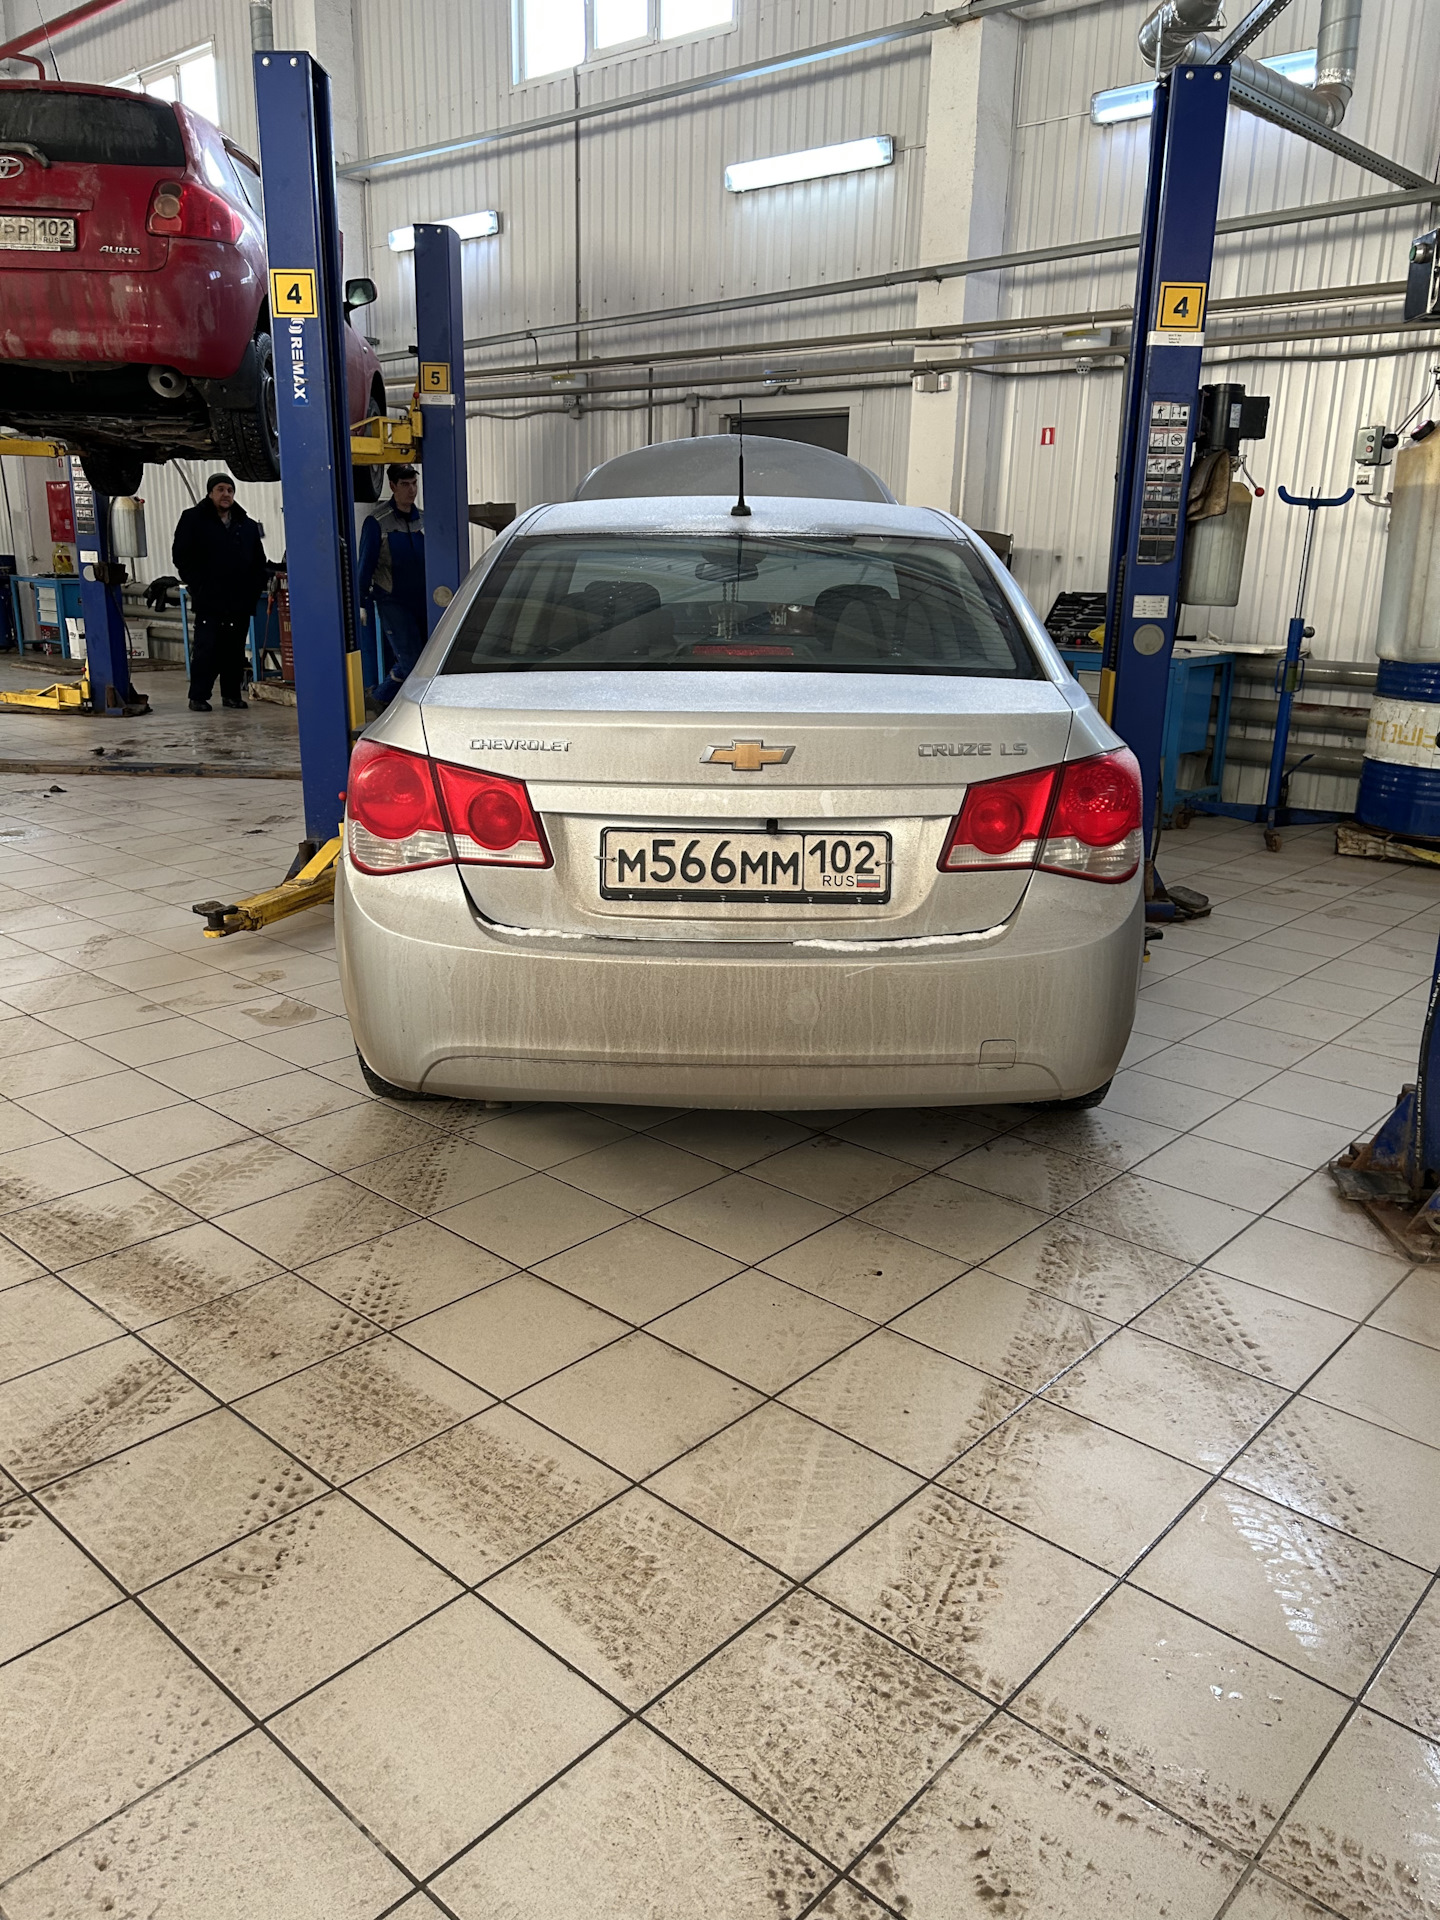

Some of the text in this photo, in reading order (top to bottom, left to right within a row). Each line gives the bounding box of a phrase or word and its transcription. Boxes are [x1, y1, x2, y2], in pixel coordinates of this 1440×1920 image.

[38, 221, 70, 236] 102
[99, 245, 141, 254] AURIS
[286, 283, 302, 304] 4
[1173, 296, 1189, 318] 4
[290, 337, 307, 399] REMAX
[431, 371, 440, 385] 5
[469, 738, 573, 753] CHEVROLET
[918, 742, 1028, 757] CRUZE LS
[618, 839, 875, 885] М566ММ 102
[822, 876, 855, 886] RUS
